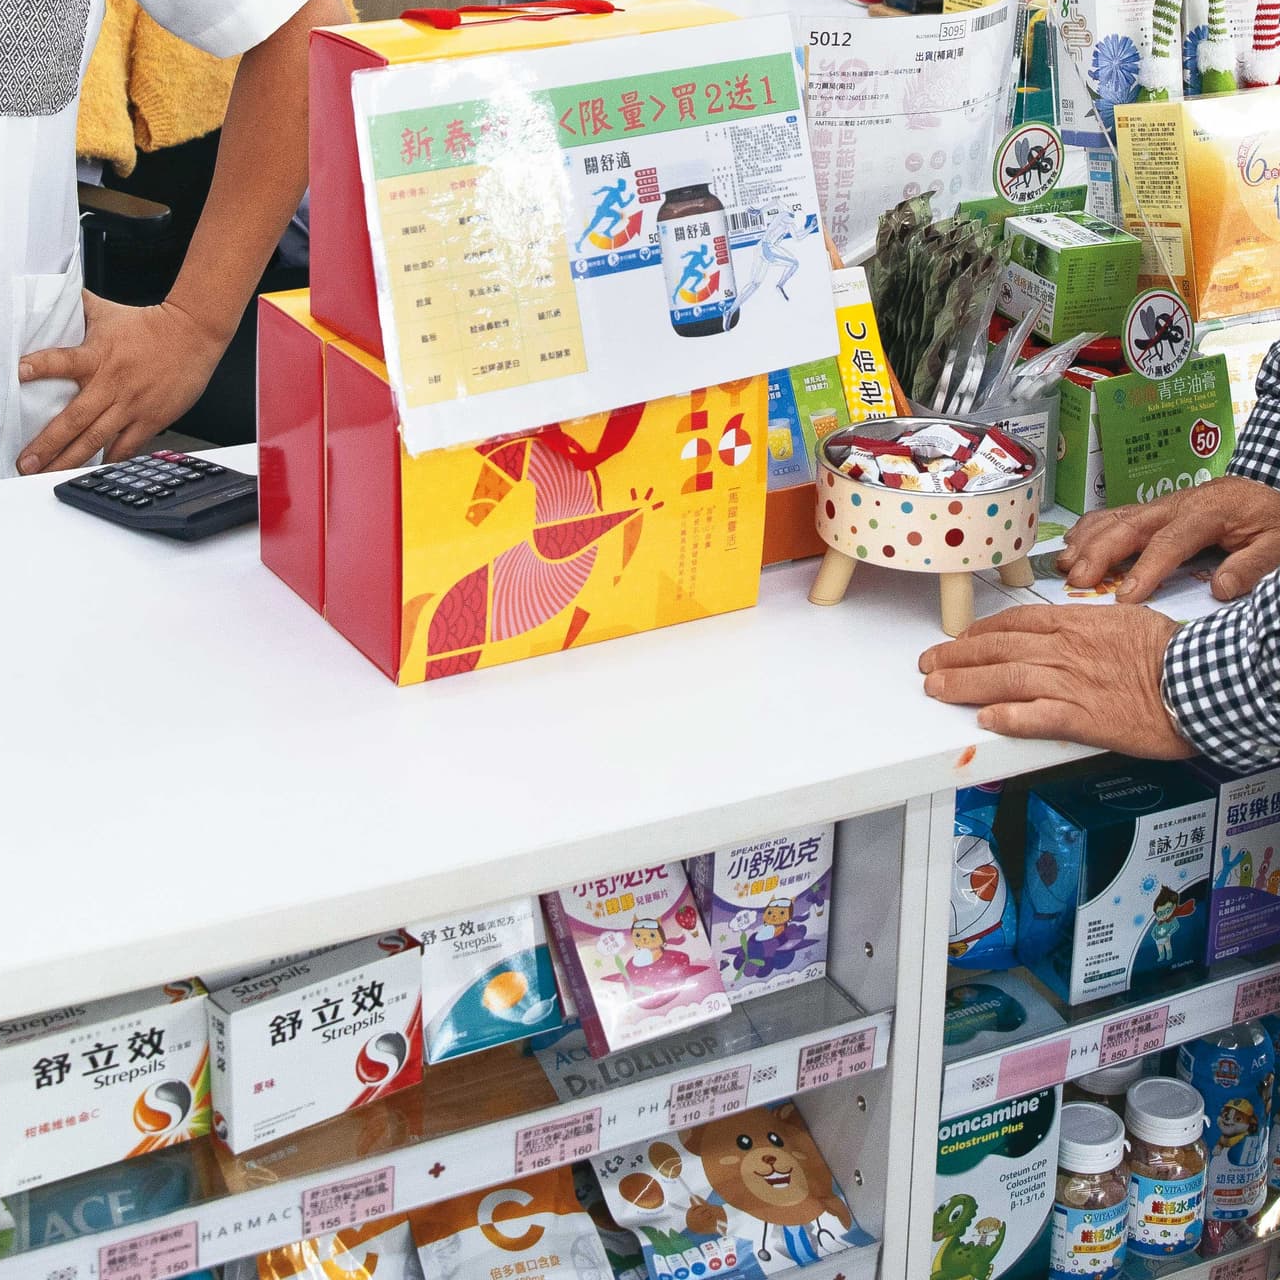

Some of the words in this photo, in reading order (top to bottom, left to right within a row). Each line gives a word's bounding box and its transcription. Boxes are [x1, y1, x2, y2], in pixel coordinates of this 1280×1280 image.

[809, 31, 852, 47] 5012
[941, 24, 965, 39] 3095
[583, 150, 632, 176] 關舒適
[674, 221, 712, 242] 關舒適
[1196, 430, 1216, 452] 50
[726, 836, 822, 881] 小舒必克
[730, 841, 772, 858] SPEAKER
[420, 919, 476, 946] 舒立效
[453, 932, 498, 953] Strepsils
[231, 963, 311, 999] Strepsils
[268, 979, 385, 1047] 舒立效
[944, 997, 1002, 1021] camine
[321, 1011, 385, 1044] Strepsils
[1110, 1048, 1128, 1060] 850
[1142, 1038, 1160, 1051] 800
[32, 1026, 166, 1091] 舒立效
[848, 1060, 866, 1073] 100
[93, 1059, 167, 1091] Strepsils
[811, 1072, 829, 1085] 110
[721, 1099, 740, 1112] 100
[682, 1110, 701, 1123] 110
[938, 1095, 1040, 1142] omcamine
[940, 1129, 1000, 1156] Colostrum
[1001, 1121, 1025, 1138] Plus
[573, 1143, 592, 1157] 160
[531, 1155, 551, 1169] 165
[999, 1165, 1030, 1184] Osteum
[1031, 1158, 1048, 1173] CPP
[1006, 1169, 1047, 1192] Colostrum
[1009, 1180, 1047, 1201] Fucoidan
[365, 1204, 386, 1217] 150
[476, 1188, 545, 1252] C
[201, 1206, 302, 1243] HARMAC
[319, 1217, 342, 1231] 155
